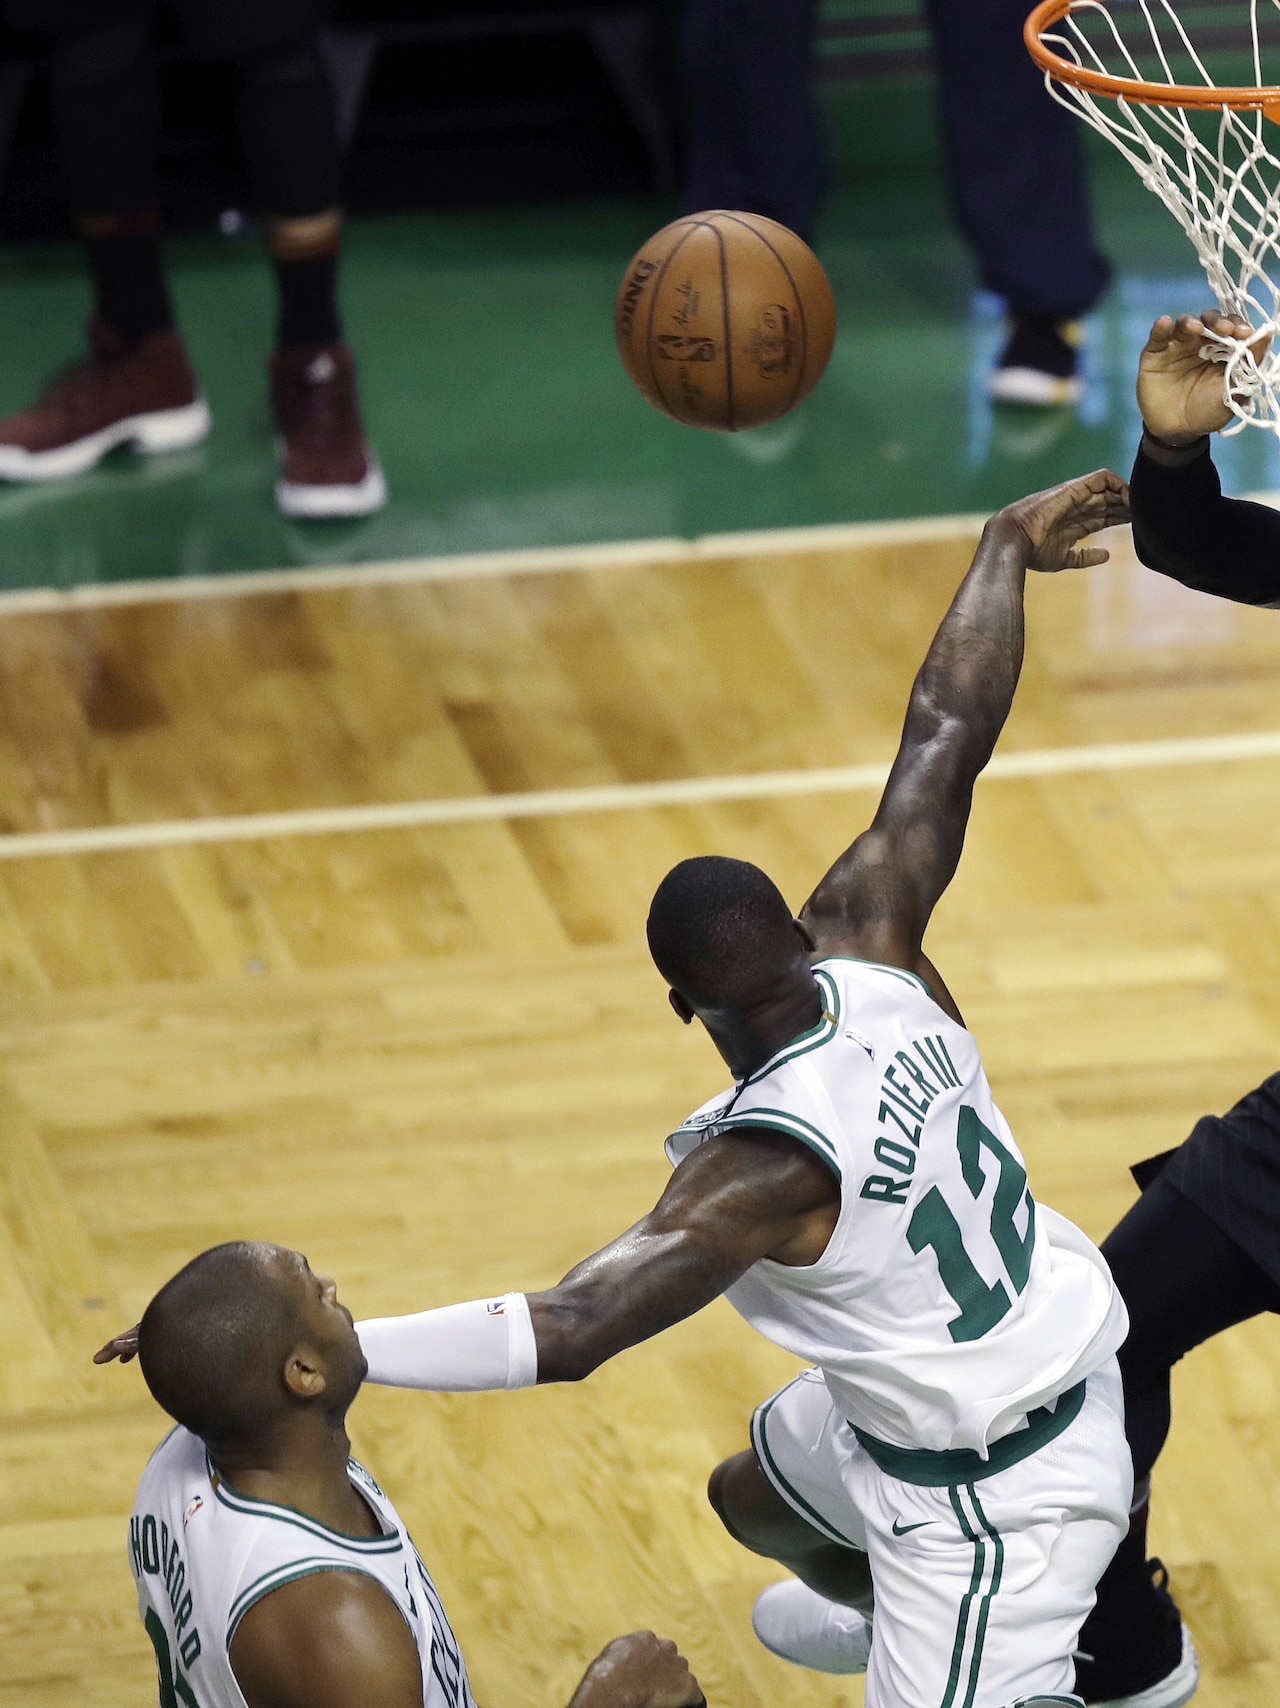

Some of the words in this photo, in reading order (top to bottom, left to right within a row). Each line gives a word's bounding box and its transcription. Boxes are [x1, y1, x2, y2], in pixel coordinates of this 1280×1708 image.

[858, 1050, 940, 1205] ROZIER
[911, 1033, 965, 1090] III
[905, 1104, 1036, 1344] 12
